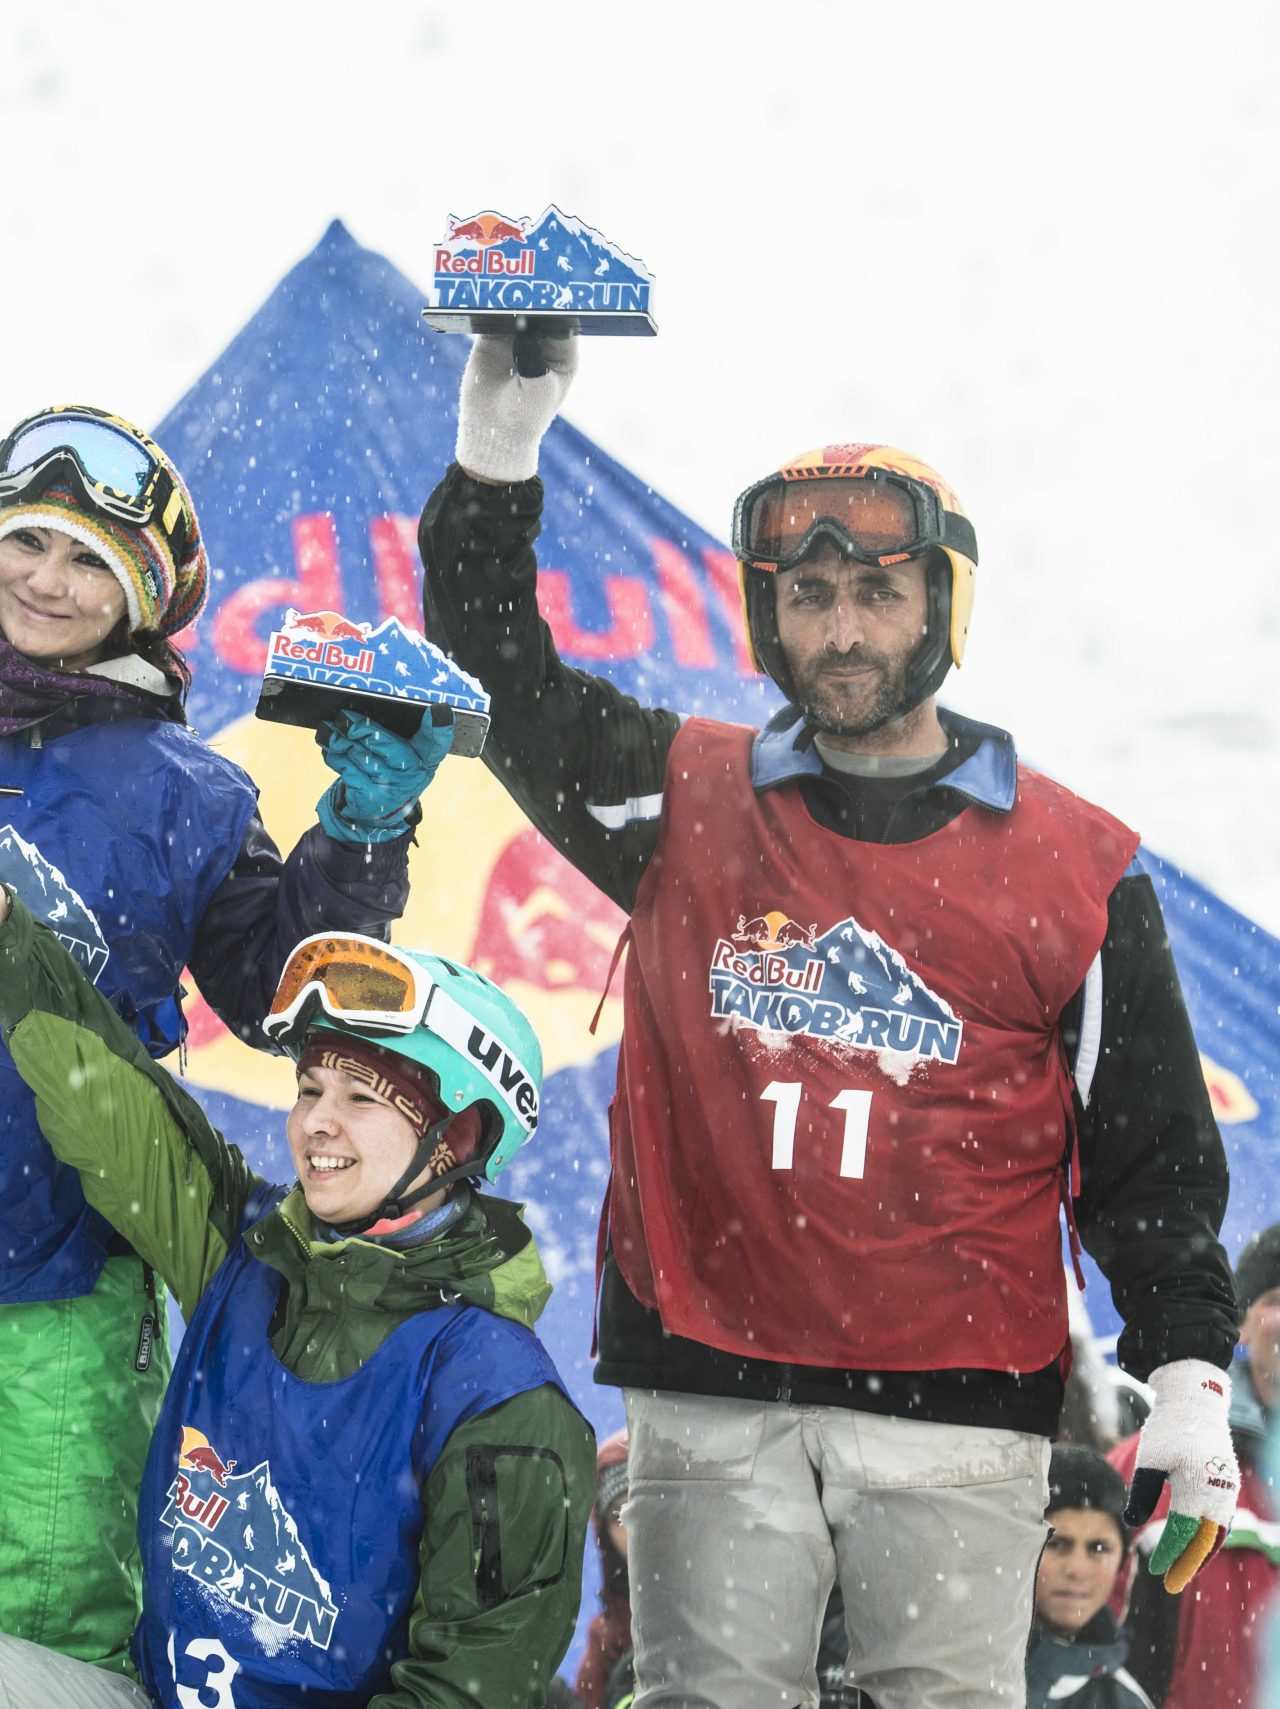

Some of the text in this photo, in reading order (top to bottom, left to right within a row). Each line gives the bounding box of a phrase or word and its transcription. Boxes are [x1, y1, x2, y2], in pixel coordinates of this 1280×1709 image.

[435, 250, 535, 275] Red Bull
[434, 279, 651, 311] TAKOB RUN
[273, 634, 375, 674] Red Bull
[713, 941, 824, 992] Red Bull
[711, 977, 962, 1064] TAKOB RUN
[759, 1080, 874, 1180] 11
[138, 1323, 151, 1364] BRUGI
[237, 1565, 336, 1649] RUN
[168, 1632, 239, 1709] 3
